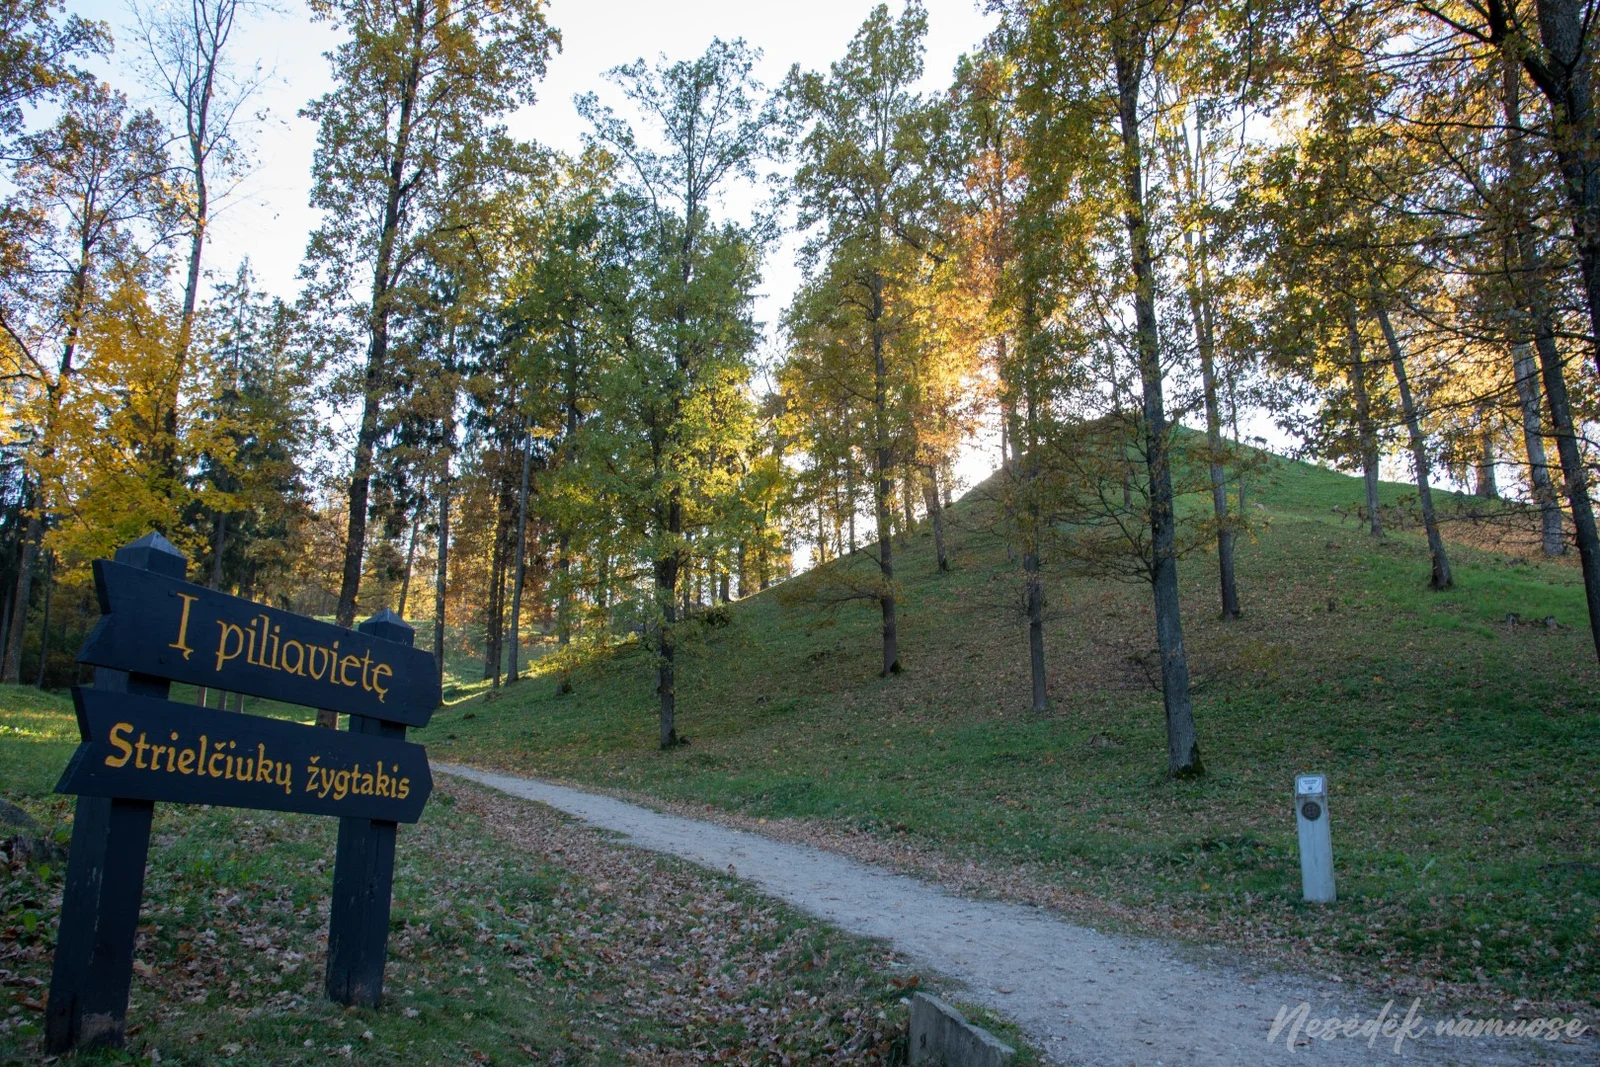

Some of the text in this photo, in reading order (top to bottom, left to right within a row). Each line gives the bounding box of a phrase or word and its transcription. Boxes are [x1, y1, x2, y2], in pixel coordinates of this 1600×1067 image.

[168, 592, 394, 703] Į piliavietę
[104, 721, 411, 800] Strielčiukų žygtakis
